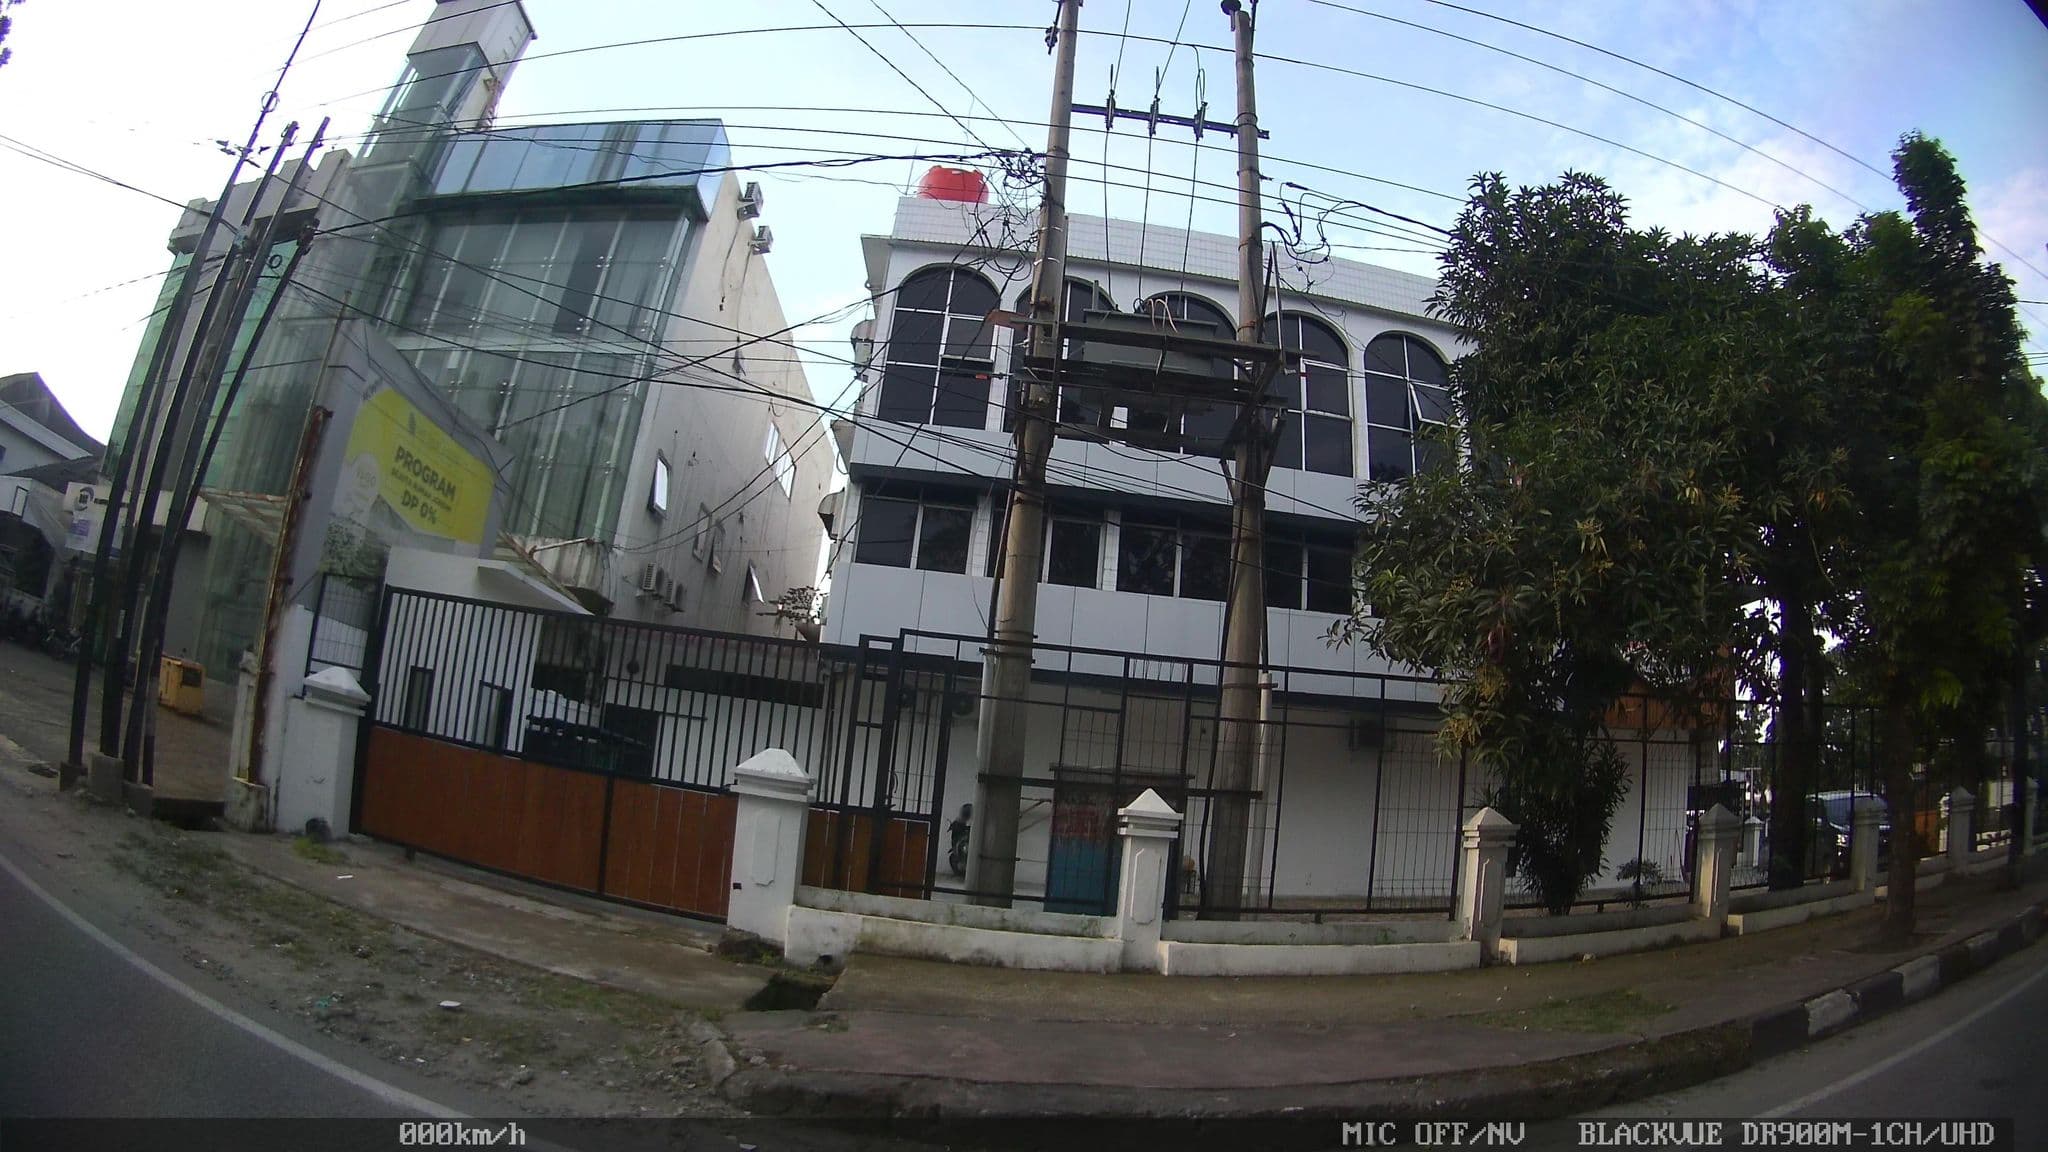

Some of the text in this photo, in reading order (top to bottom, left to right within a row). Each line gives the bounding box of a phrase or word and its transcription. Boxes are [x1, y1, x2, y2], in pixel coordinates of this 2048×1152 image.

[395, 445, 456, 501] PROGRAM
[401, 489, 420, 511] DP
[420, 502, 439, 525] 0%
